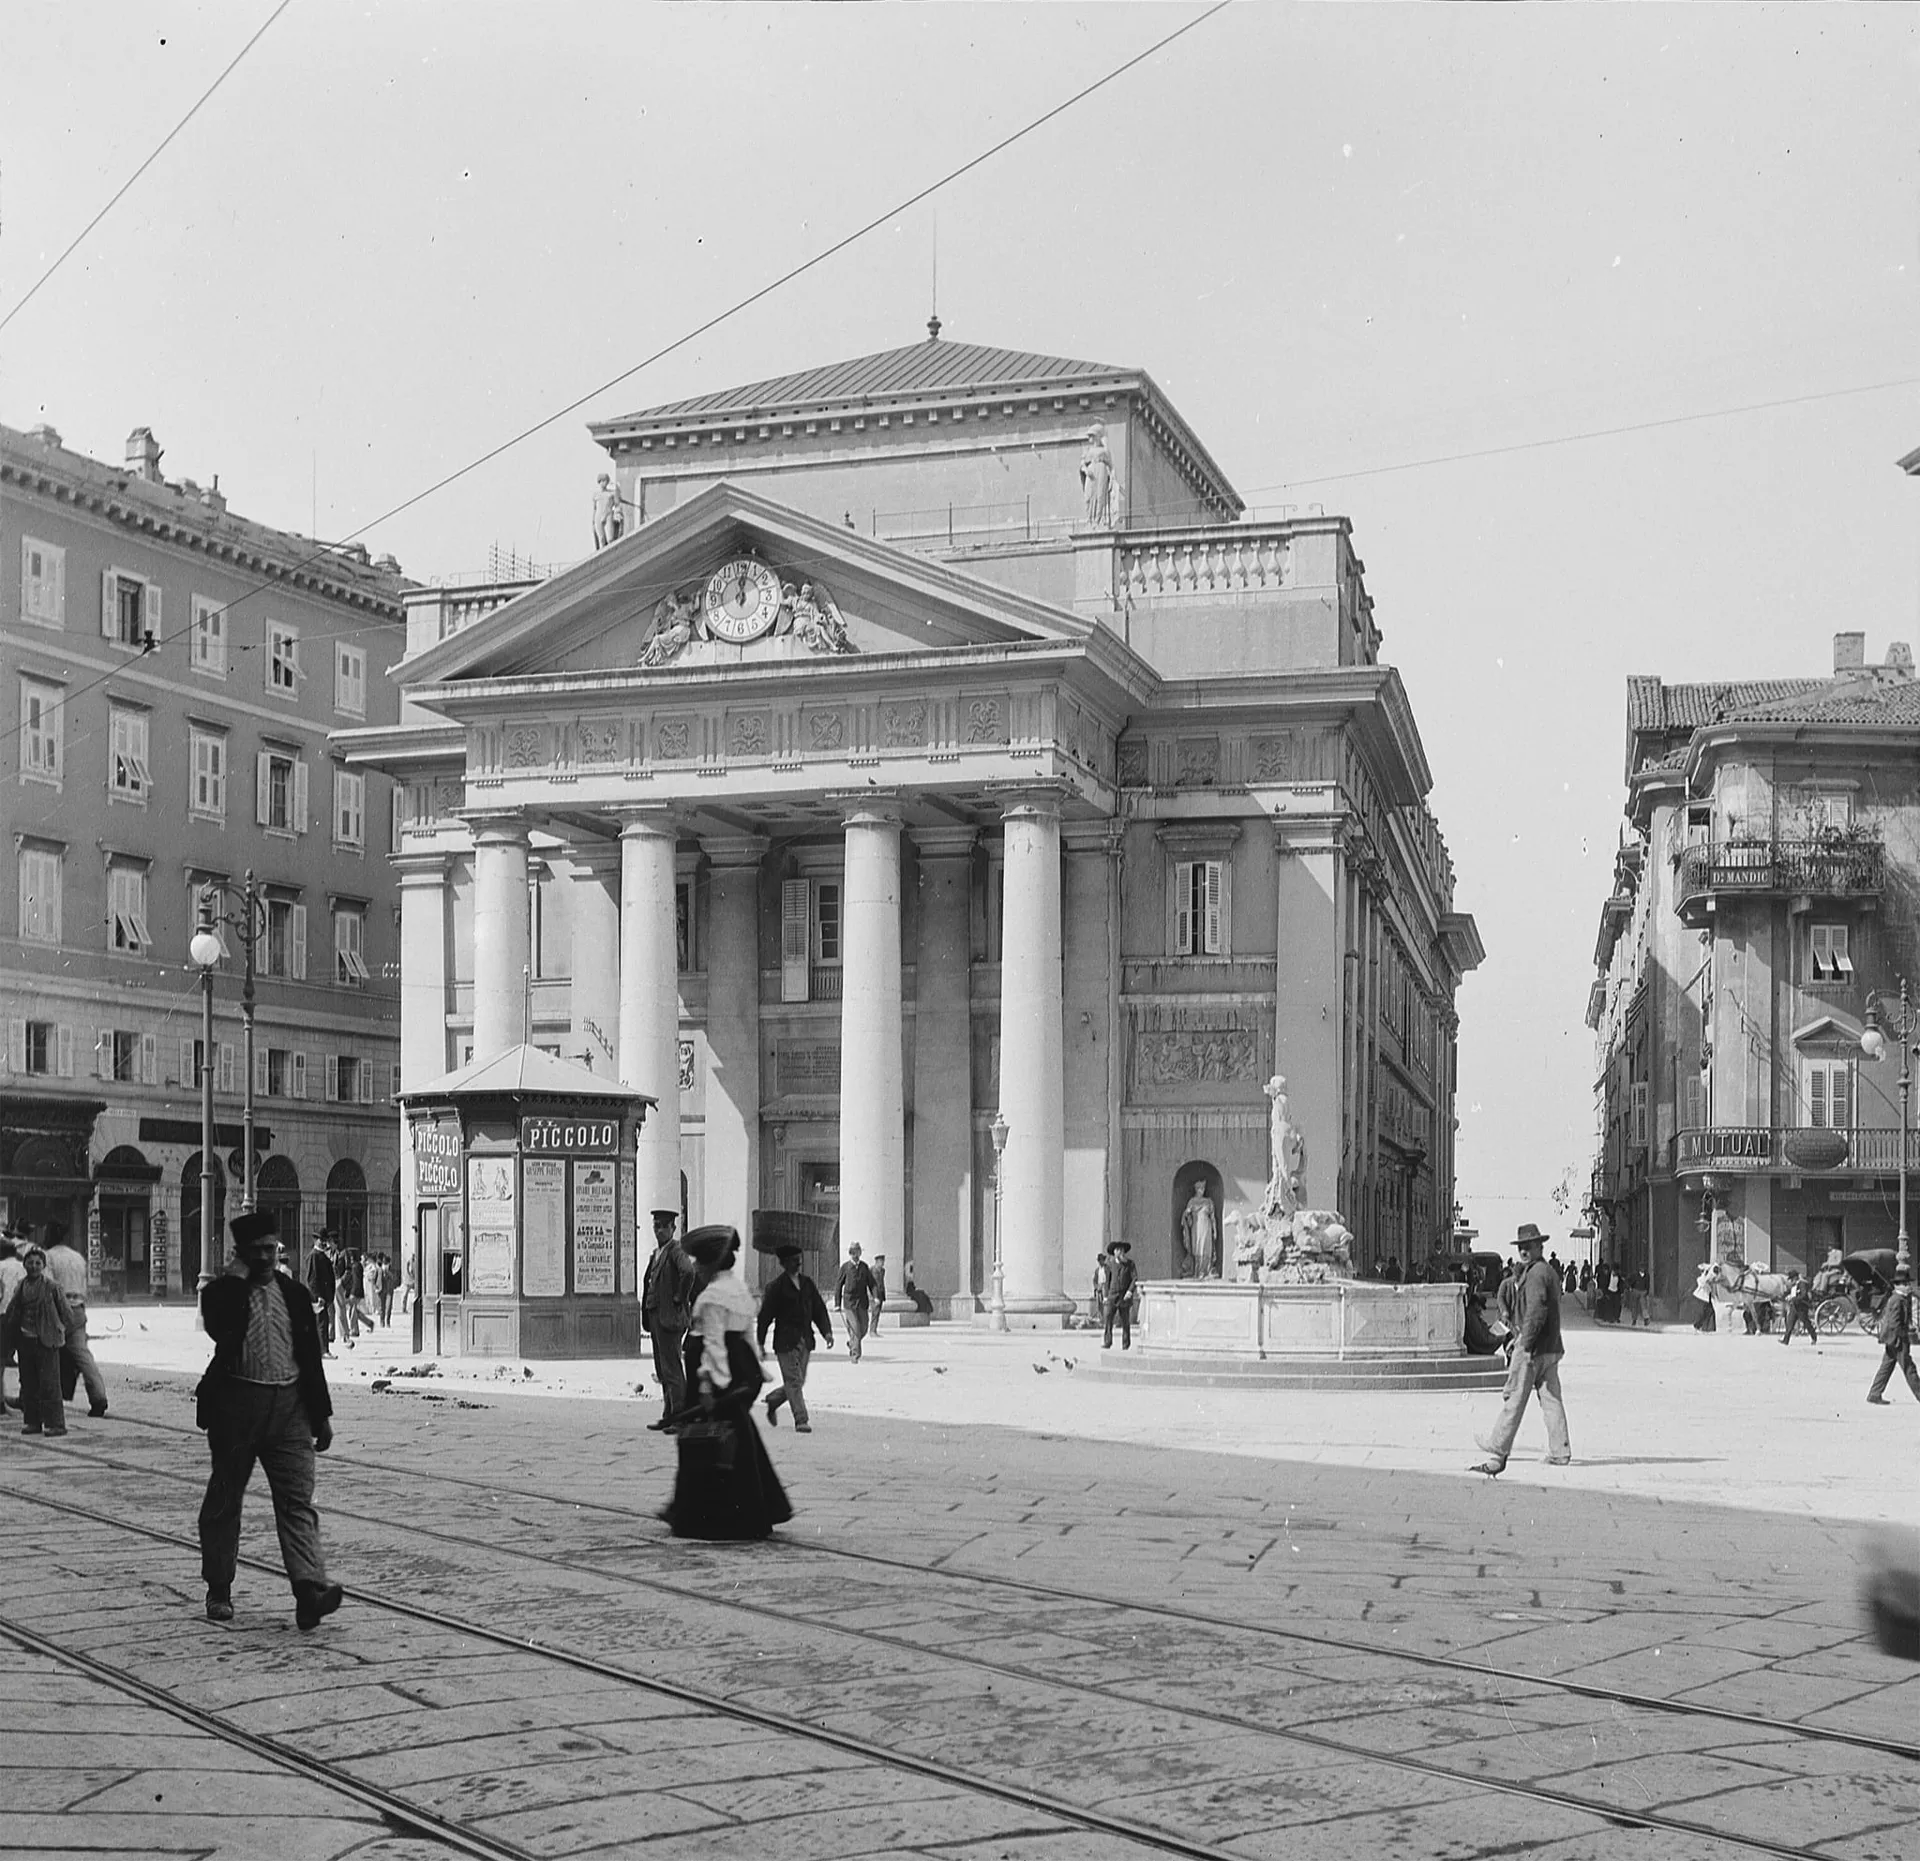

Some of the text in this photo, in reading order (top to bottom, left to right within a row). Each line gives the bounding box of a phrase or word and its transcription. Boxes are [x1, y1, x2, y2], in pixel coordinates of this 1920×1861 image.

[723, 566, 731, 578] 11
[713, 579, 722, 591] 10
[762, 574, 768, 585] 2
[710, 595, 717, 606] 9
[765, 590, 772, 601] 3
[713, 610, 720, 621] 8
[762, 607, 768, 618] 4
[725, 621, 731, 632] 7
[737, 623, 744, 634] 6
[751, 619, 758, 630] 5
[530, 1125, 611, 1148] PICCOLO
[418, 1131, 459, 1157] PICCOLO
[1692, 1133, 1768, 1156] MUTUAL
[419, 1160, 457, 1188] PICCOLO
[153, 1219, 167, 1282] BARBIERE
